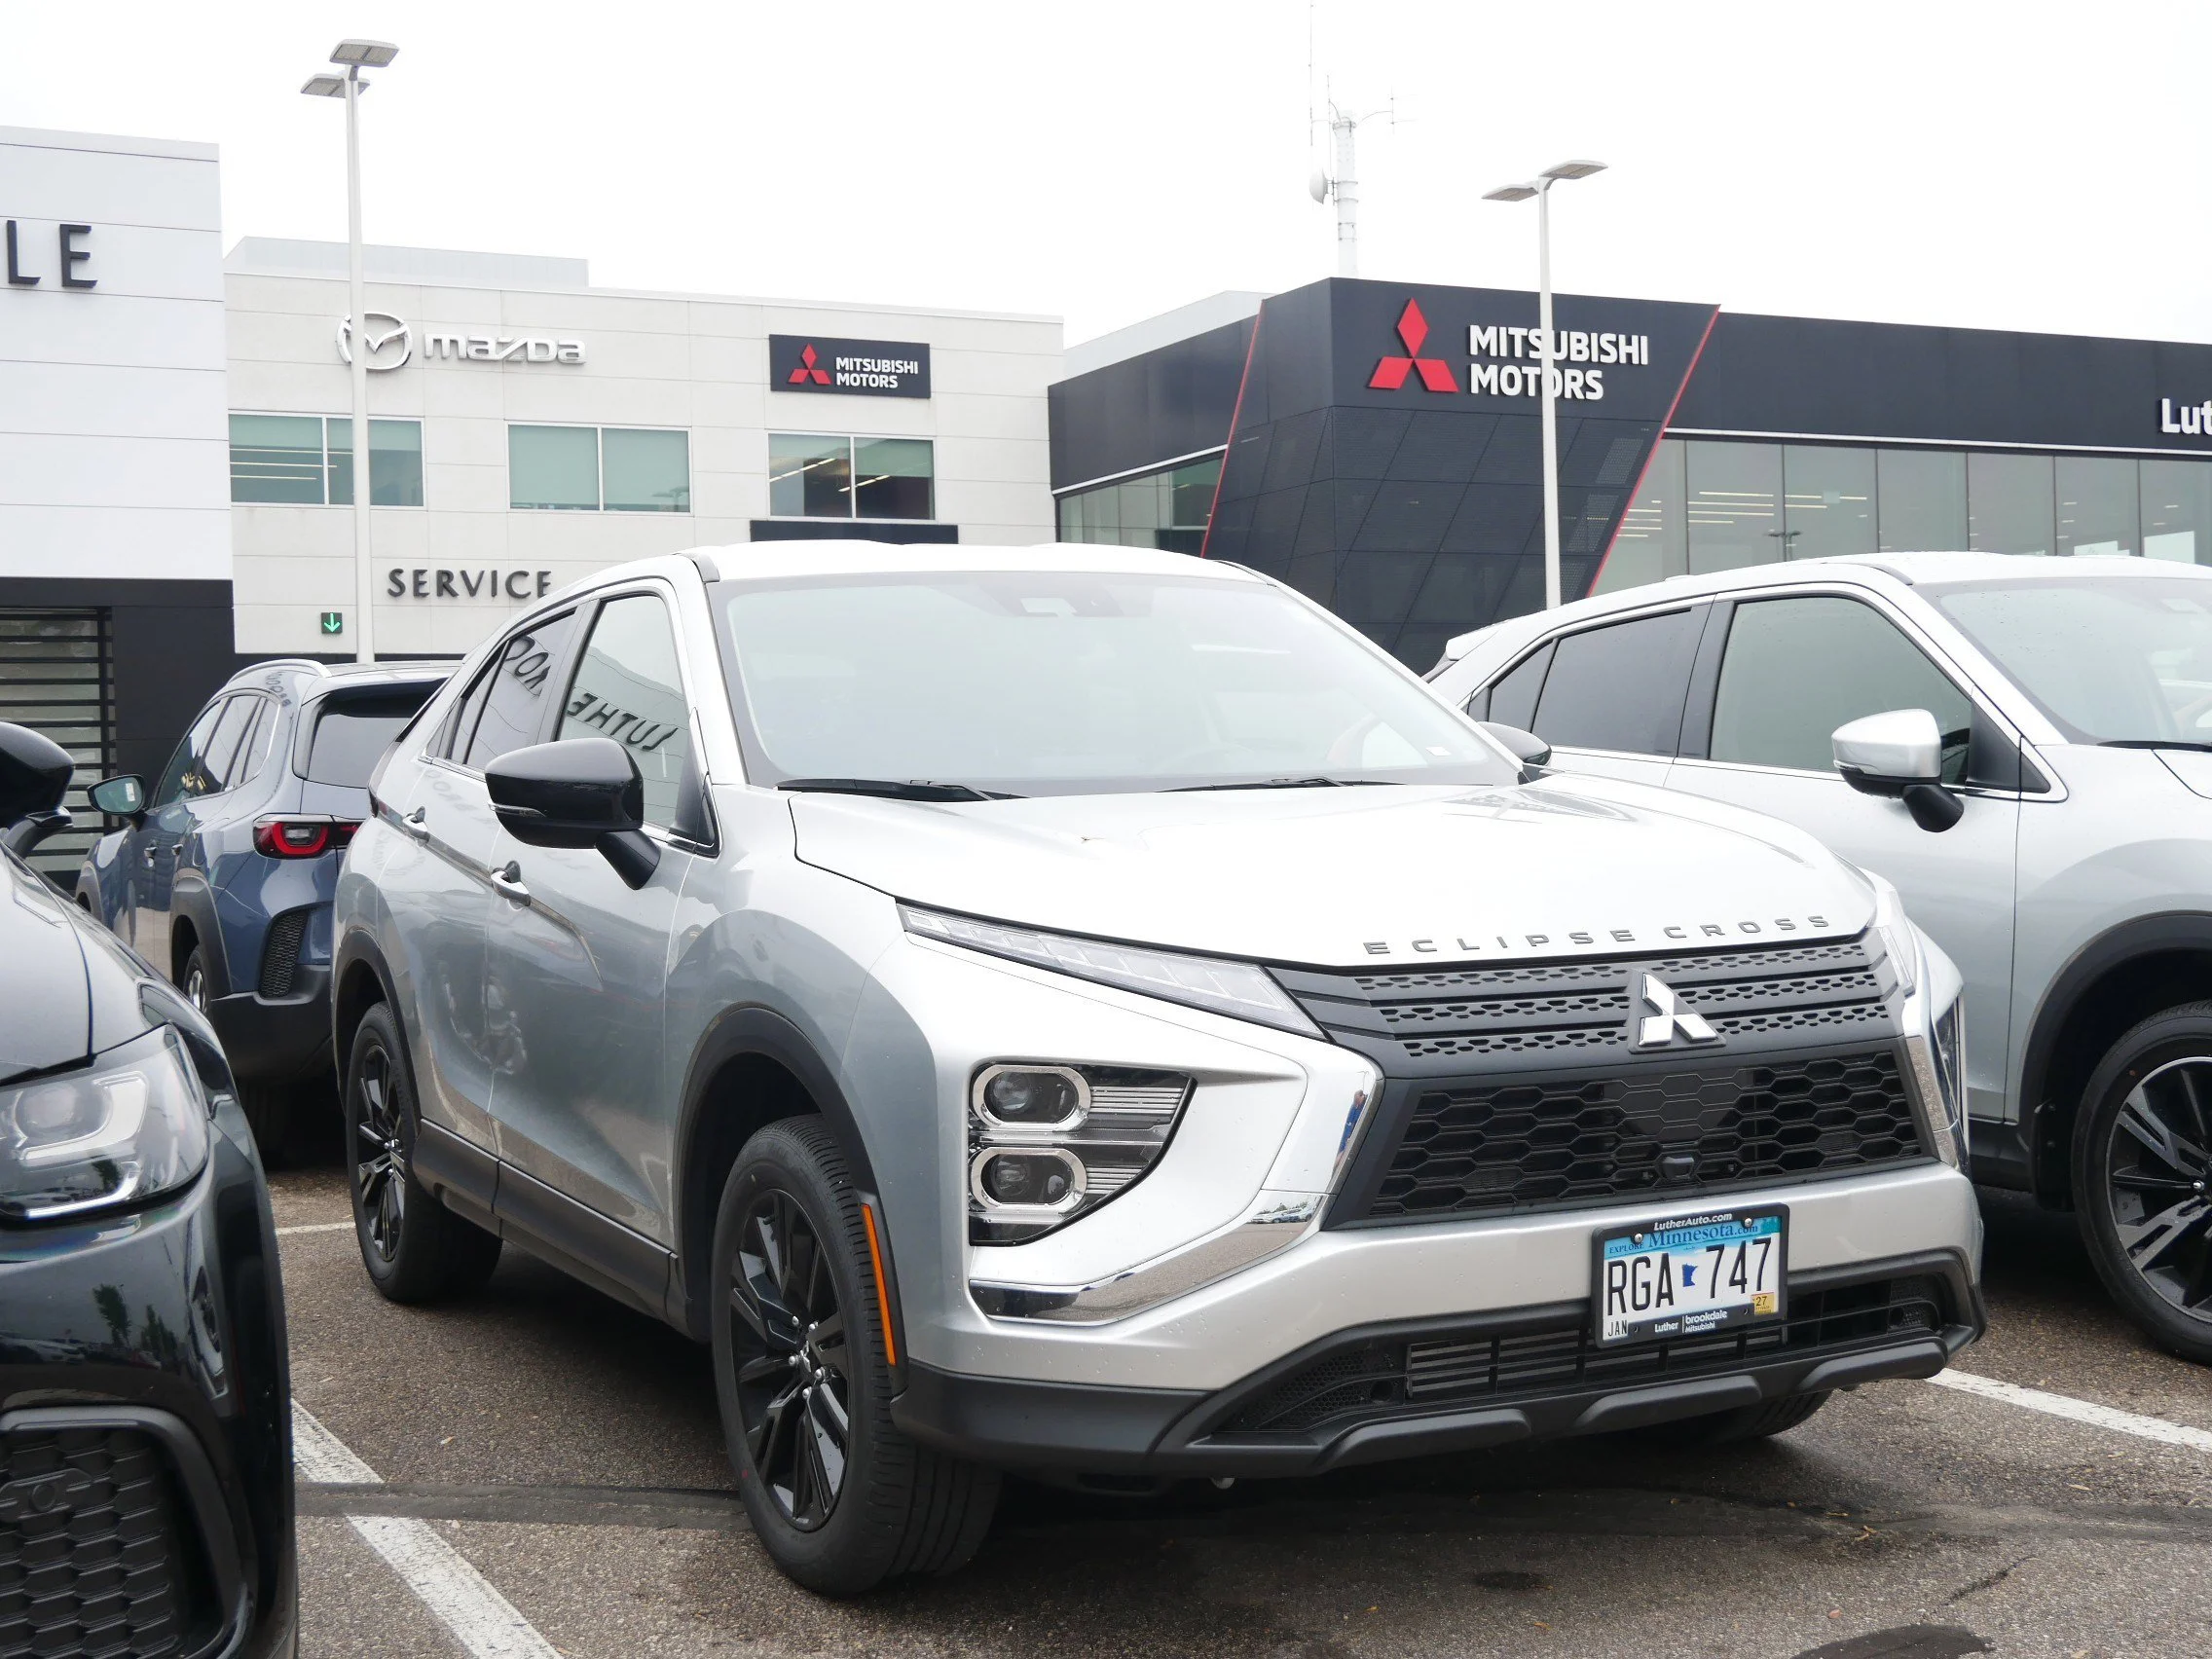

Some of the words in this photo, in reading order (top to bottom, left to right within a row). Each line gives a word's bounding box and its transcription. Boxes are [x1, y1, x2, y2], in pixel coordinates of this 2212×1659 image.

[6, 219, 98, 289] LE
[424, 332, 587, 365] mazda
[1468, 324, 1648, 365] MITSUBISHI
[835, 356, 919, 375] MITSUBISHI
[835, 372, 899, 388] MOTORS
[2160, 397, 2212, 435] Lut
[387, 568, 552, 599] SERVICE
[1363, 929, 1636, 955] ECLIPSE
[1662, 915, 1829, 940] CROSS
[1653, 1212, 1733, 1232] LutherAuto.com
[1607, 1252, 1675, 1316] RGA
[1706, 1236, 1772, 1300] 747
[1755, 1295, 1768, 1307] 27
[1654, 1320, 1679, 1333] Luther
[1685, 1309, 1728, 1325] brookdale
[1685, 1320, 1715, 1334] Mitsubishi
[1607, 1318, 1628, 1338] JAN
